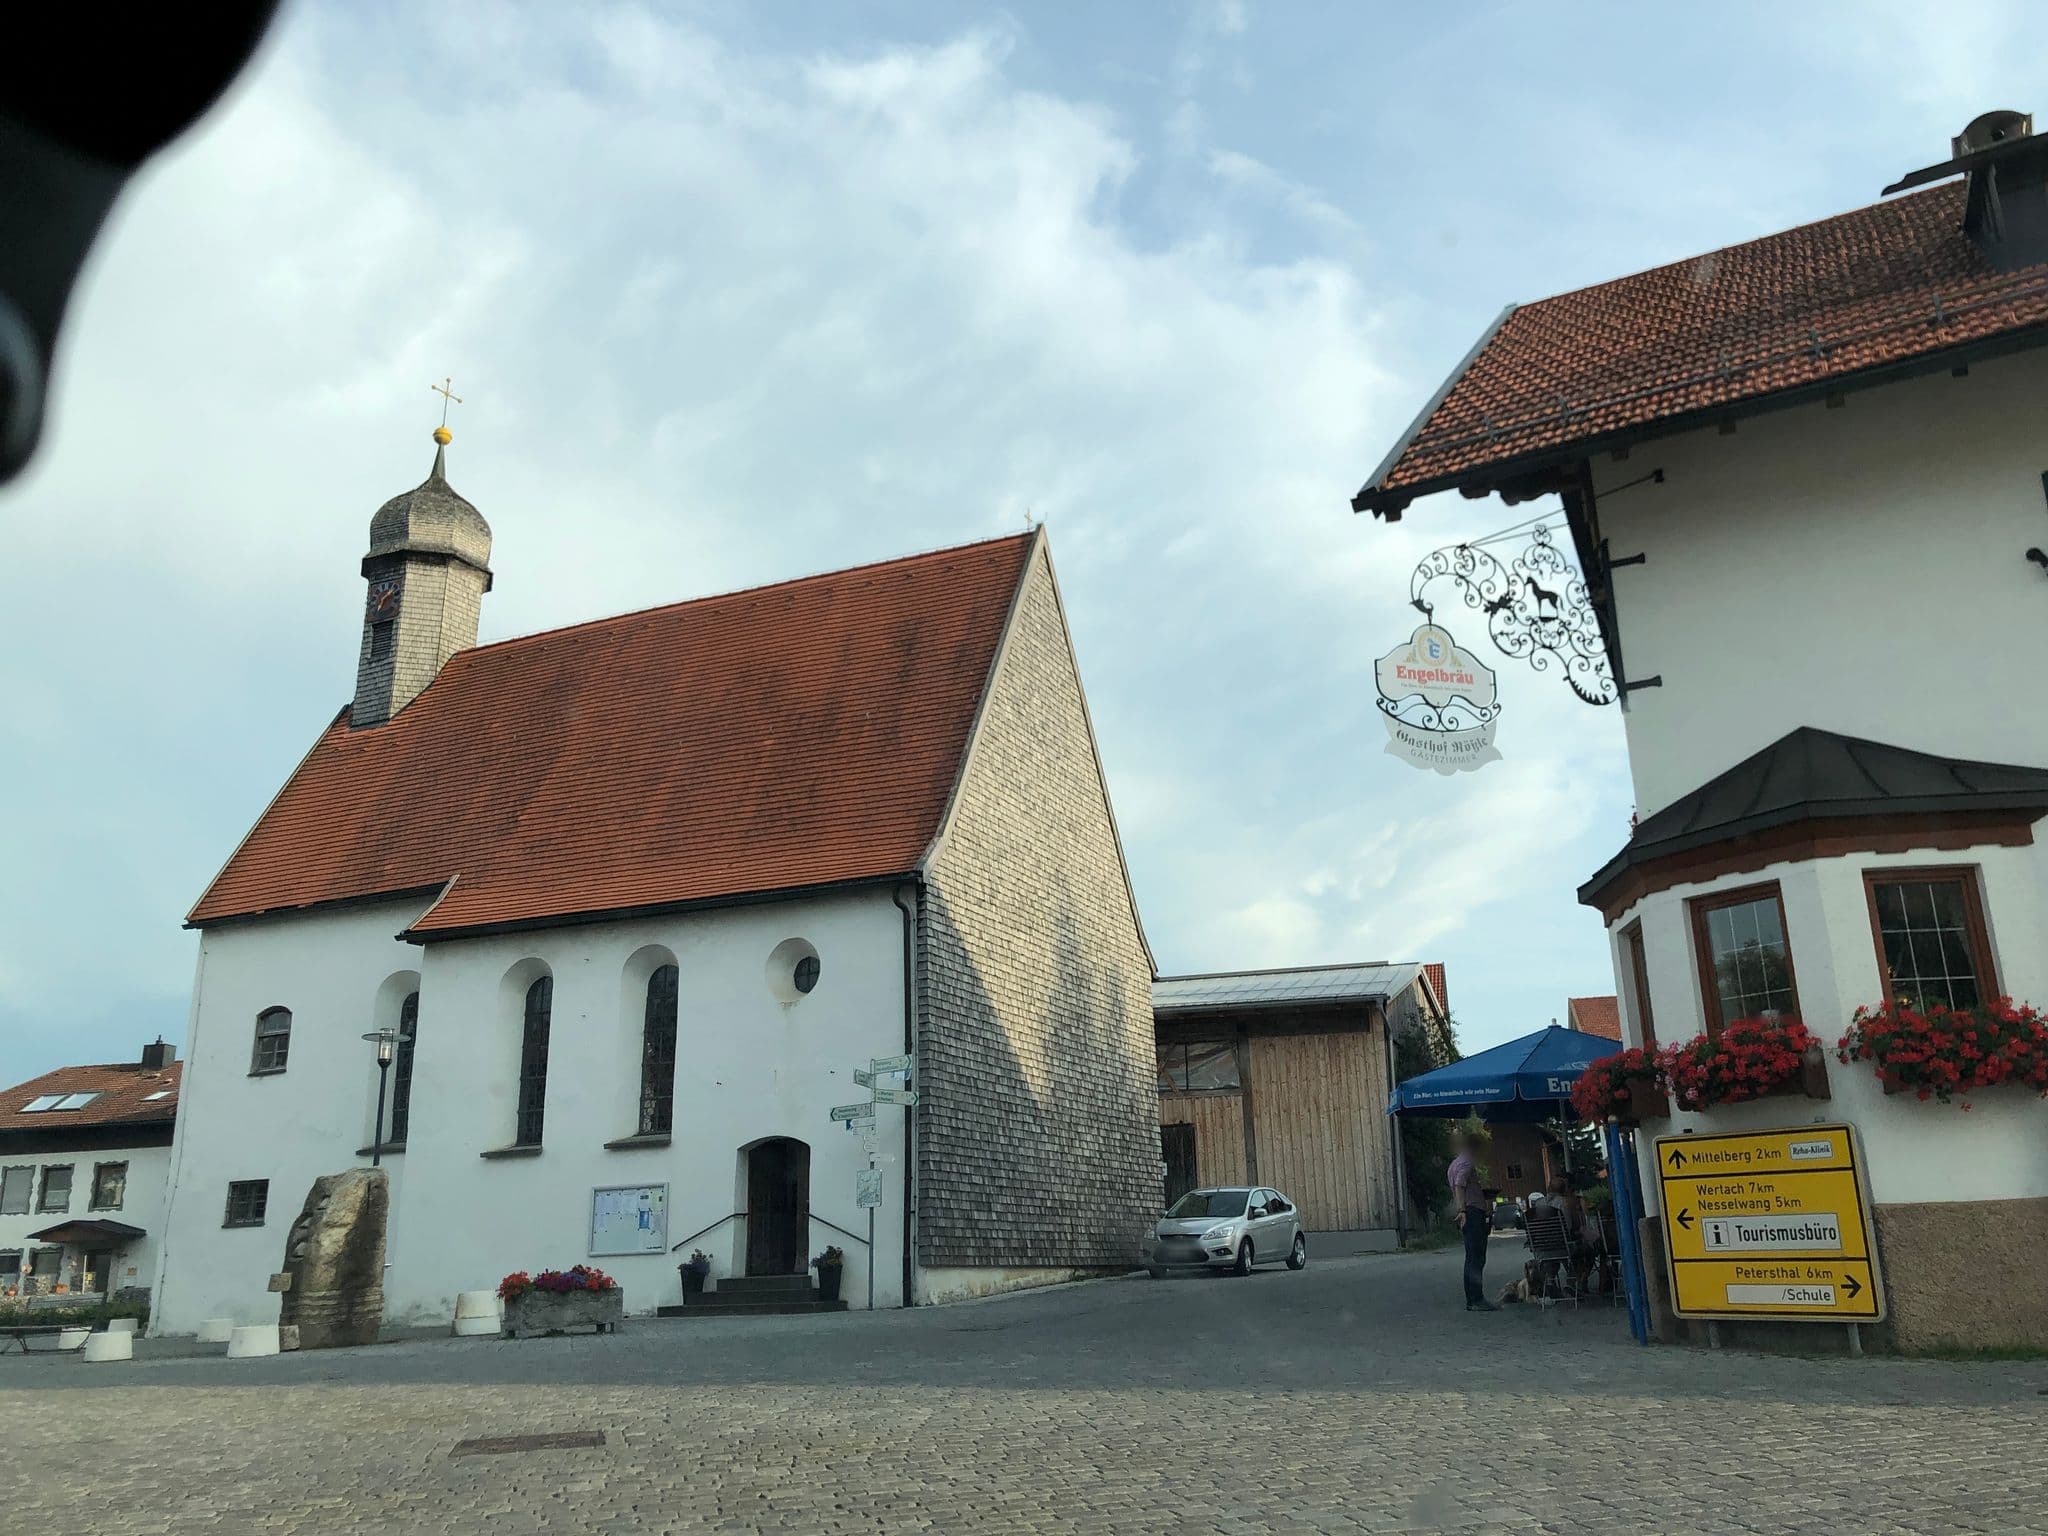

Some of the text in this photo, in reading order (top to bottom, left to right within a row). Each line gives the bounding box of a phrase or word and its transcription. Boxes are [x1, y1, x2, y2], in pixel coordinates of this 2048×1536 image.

[1396, 665, 1474, 685] Engelbräu
[1396, 729, 1448, 755] Gasthof
[1692, 1150, 1751, 1164] Mittelberg
[1696, 1183, 1744, 1195] Wertach
[1698, 1197, 1770, 1212] Nesselwang
[1735, 1223, 1837, 1242] Tourismusbüro
[1735, 1266, 1800, 1279] Petersthal
[1781, 1287, 1831, 1301] /Schule
